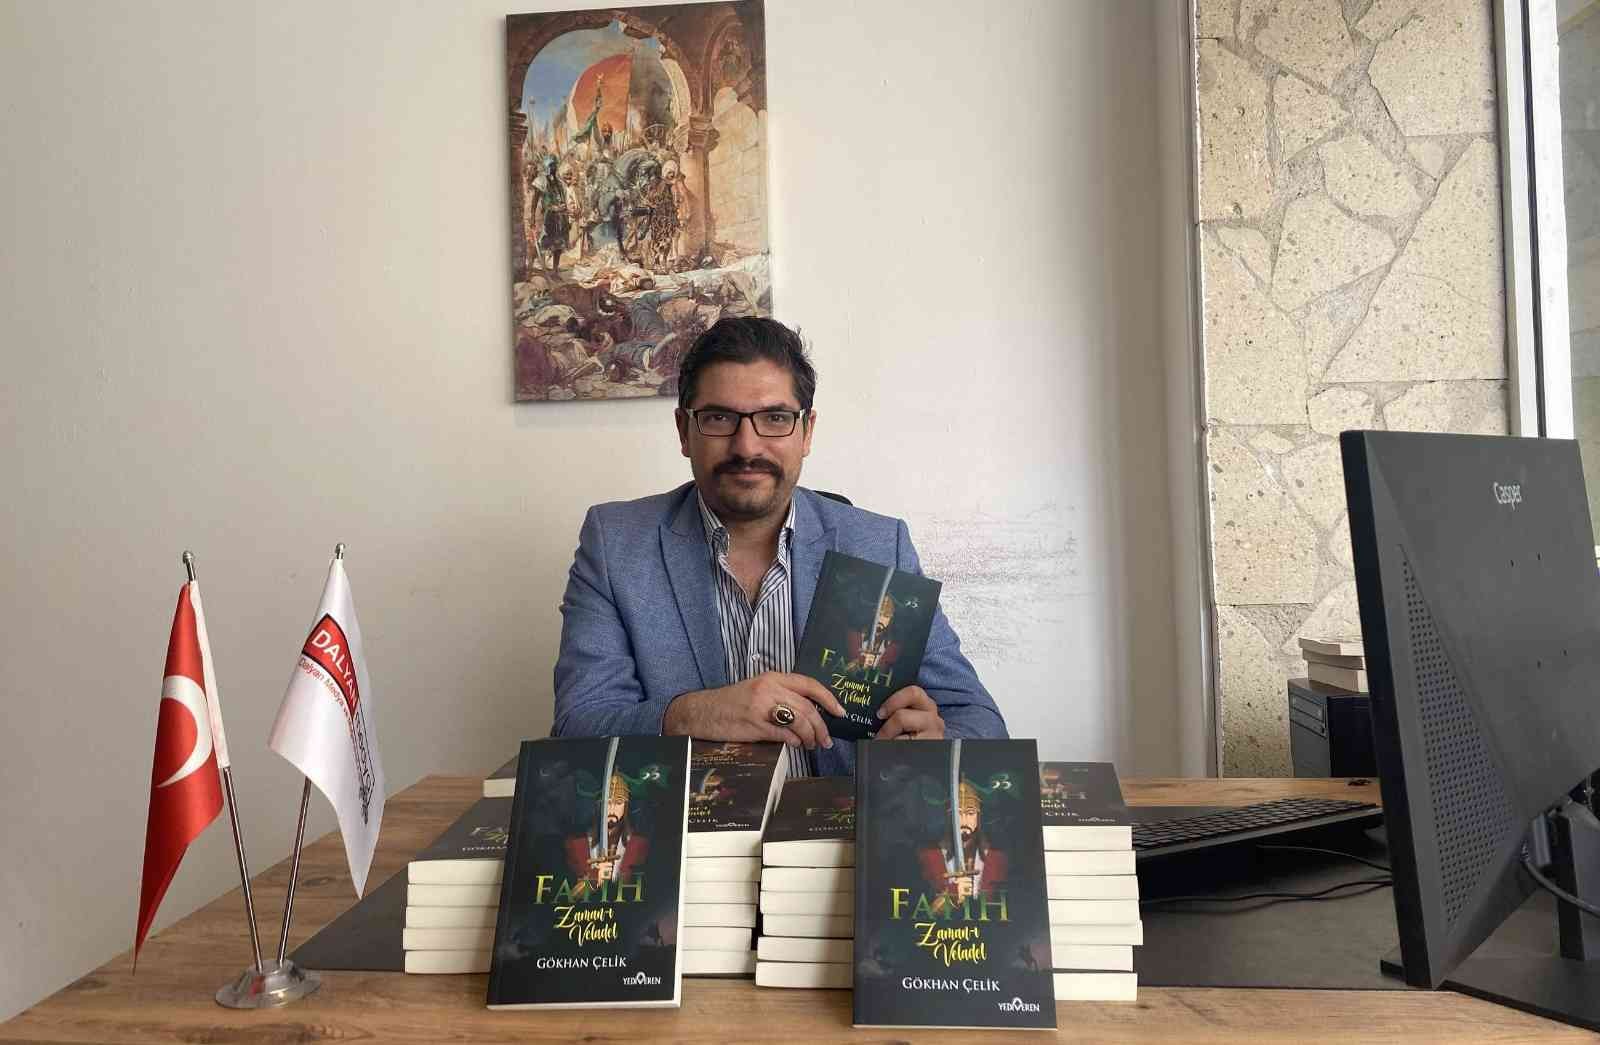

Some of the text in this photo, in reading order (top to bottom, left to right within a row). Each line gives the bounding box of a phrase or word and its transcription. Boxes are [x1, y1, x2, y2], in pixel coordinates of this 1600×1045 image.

[1493, 481, 1522, 511] Casper
[536, 955, 627, 972] GÖKHAN ÇELİK
[902, 976, 1001, 993] GÖKHAN ÇELİK
